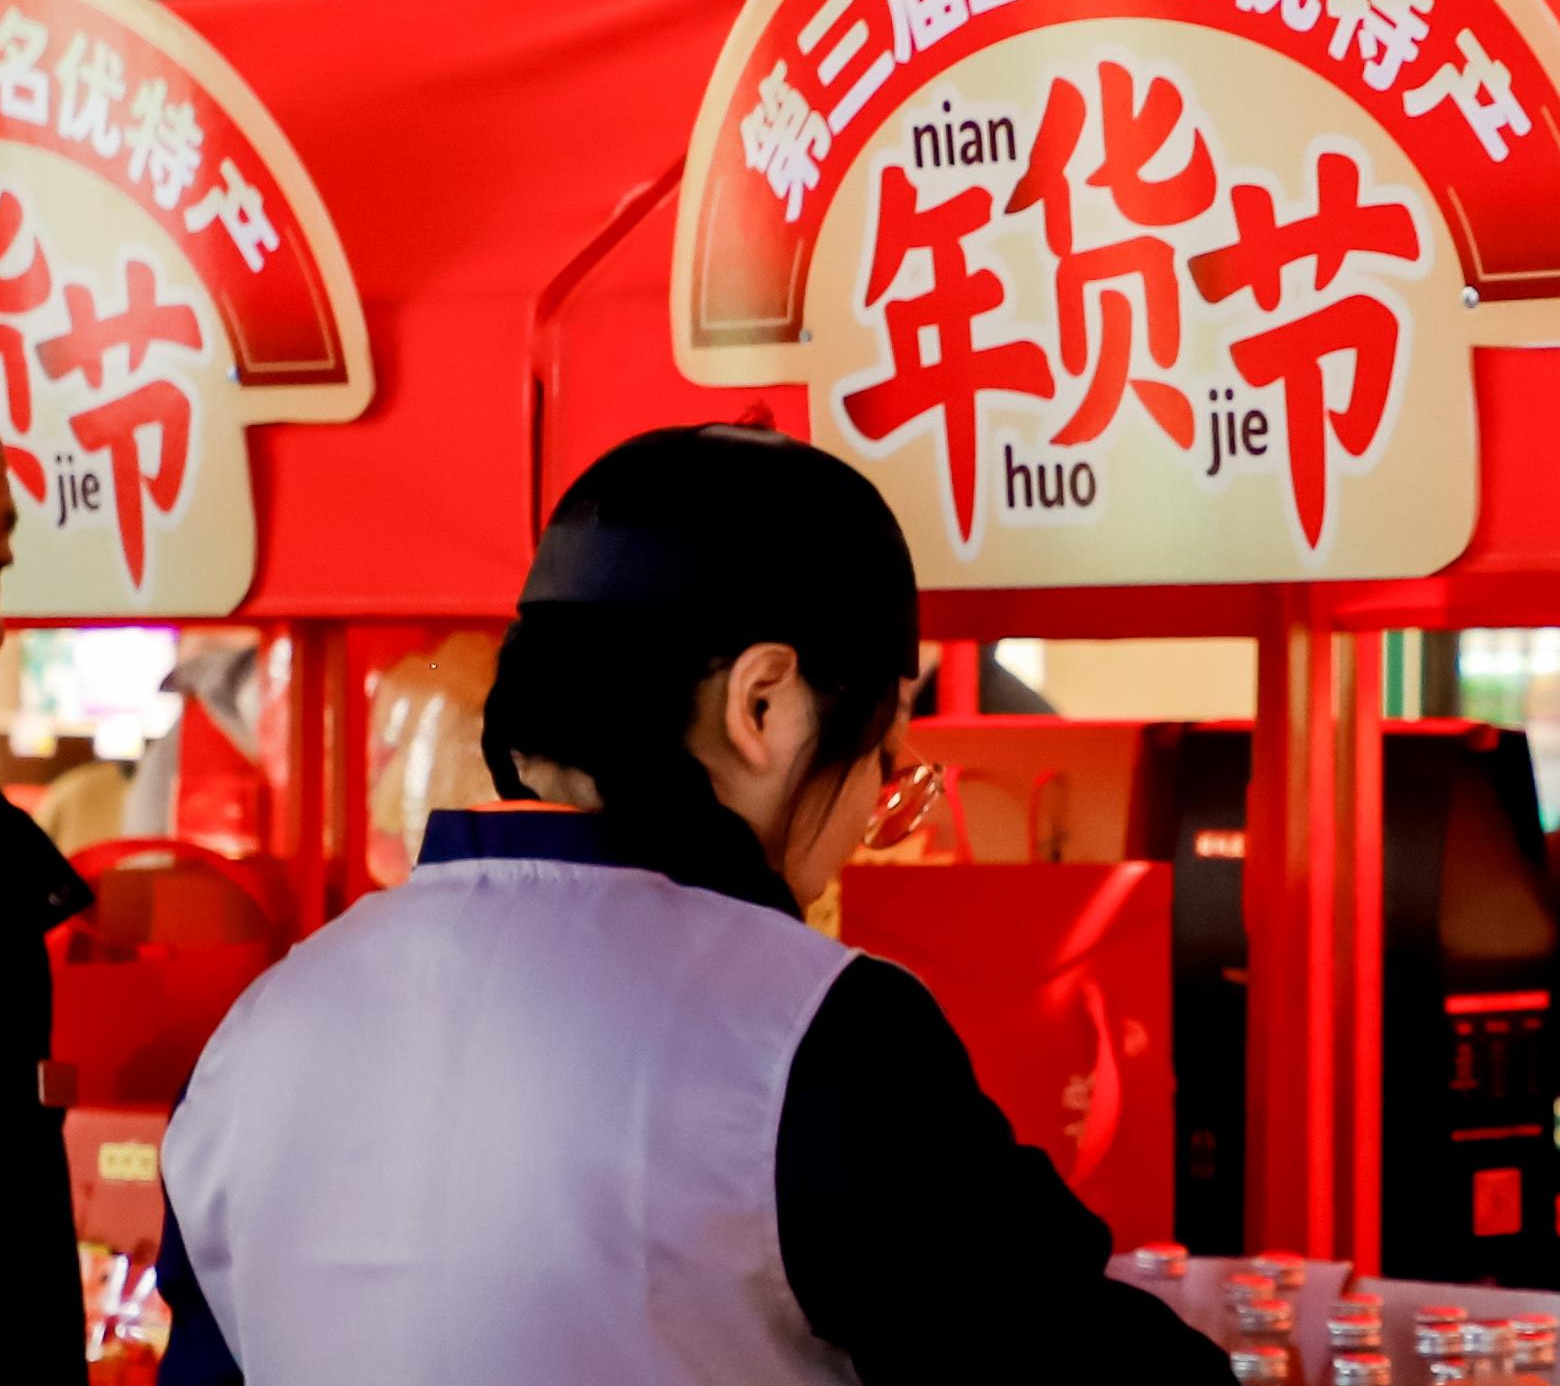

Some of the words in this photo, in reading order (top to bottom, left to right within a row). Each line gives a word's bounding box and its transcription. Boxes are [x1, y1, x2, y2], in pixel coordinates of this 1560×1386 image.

[910, 100, 1018, 172] nian
[842, 60, 1420, 552] 年货节
[1204, 388, 1272, 475] jie
[53, 454, 101, 524] jie
[1005, 444, 1097, 511] huo
